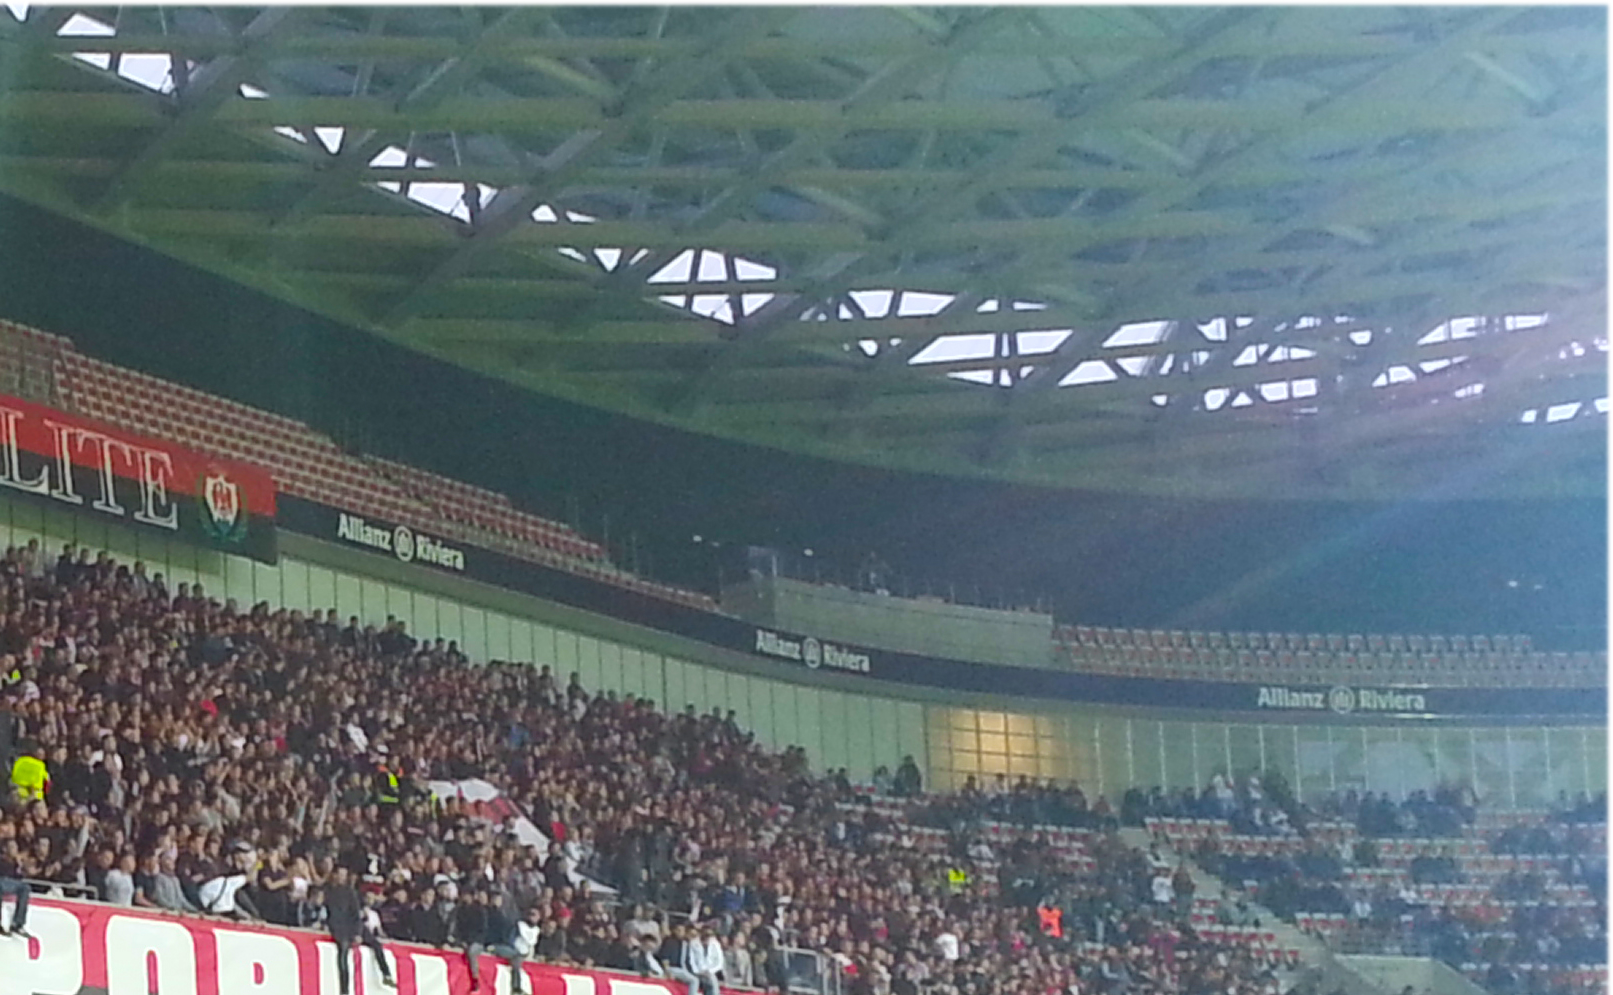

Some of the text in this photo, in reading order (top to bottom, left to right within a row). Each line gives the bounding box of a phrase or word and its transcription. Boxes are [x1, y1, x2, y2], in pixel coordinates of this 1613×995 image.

[338, 513, 465, 571] Allianz Riviera
[756, 629, 870, 672] Allianz Riviera
[1257, 686, 1425, 710] Allianz Riviera
